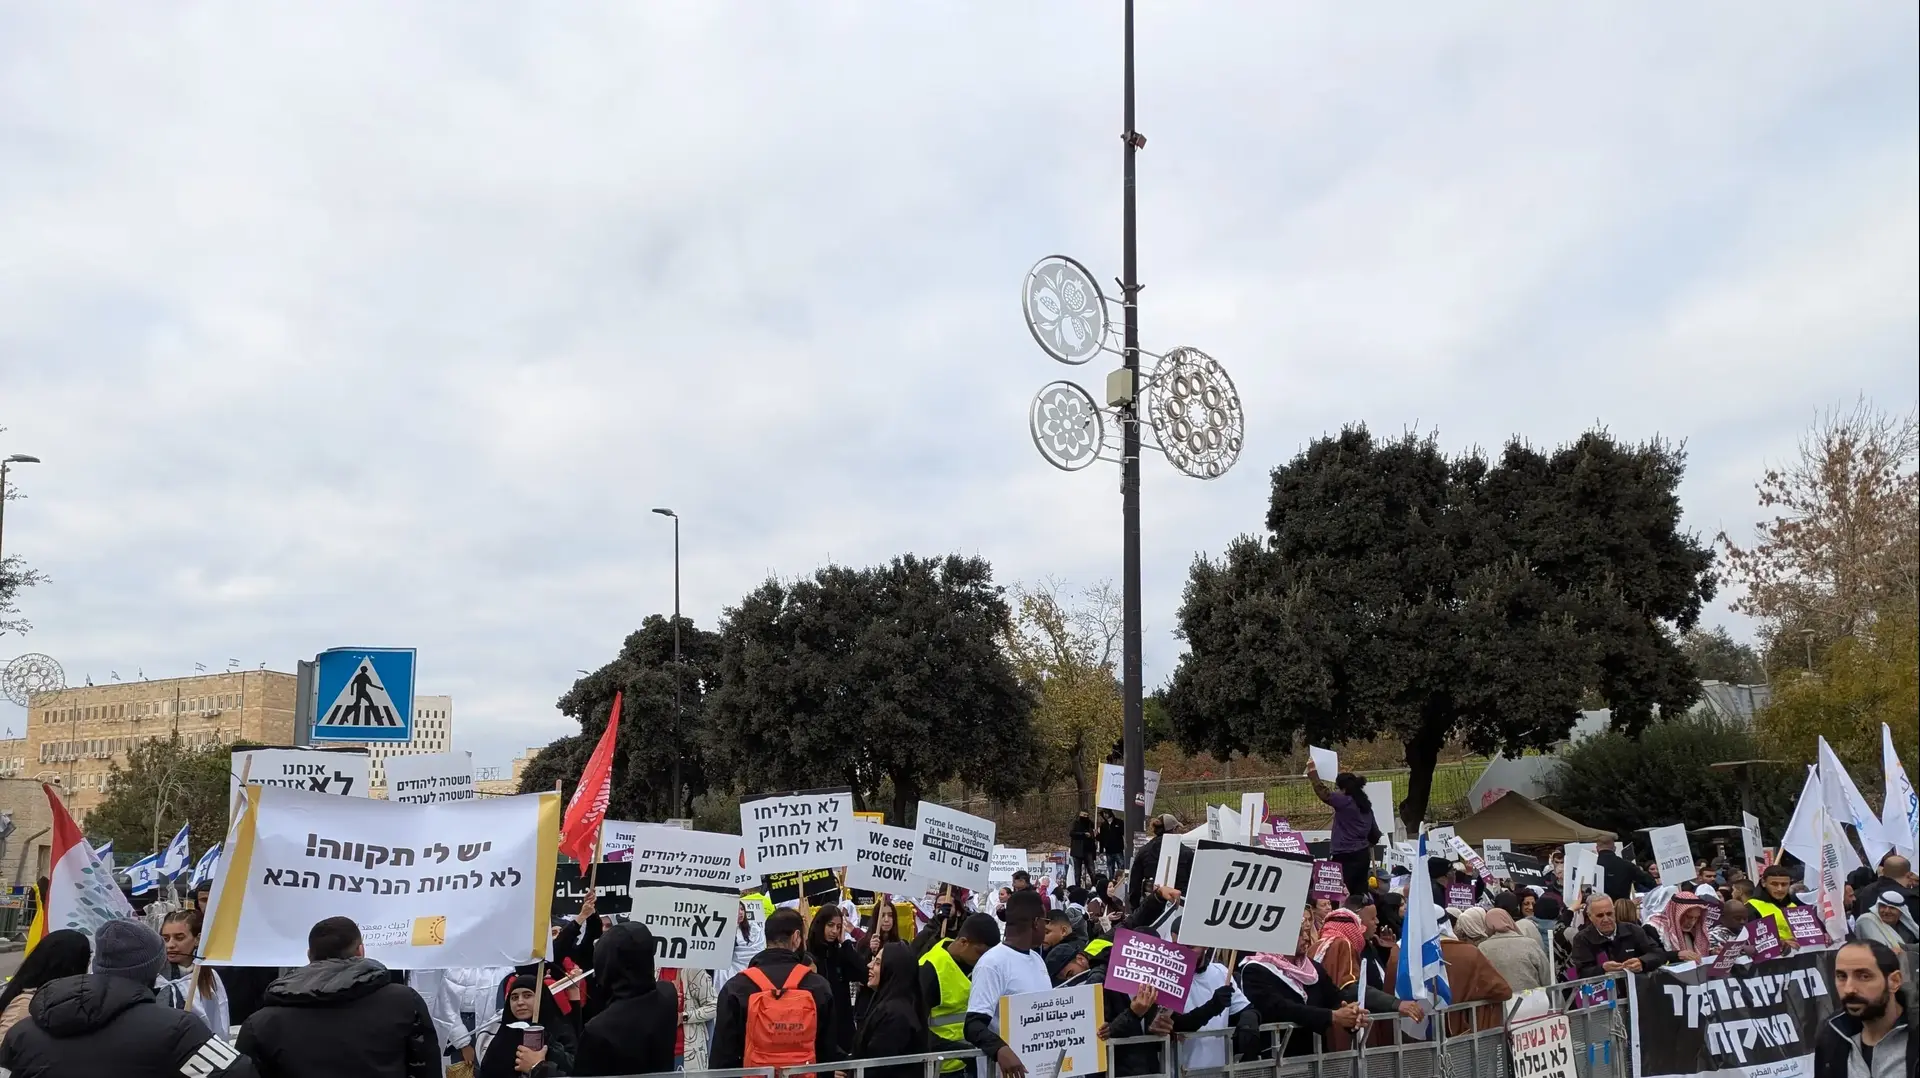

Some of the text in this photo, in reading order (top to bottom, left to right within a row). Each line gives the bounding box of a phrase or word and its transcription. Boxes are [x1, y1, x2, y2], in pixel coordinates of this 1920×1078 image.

[282, 764, 326, 775] אנחנו
[397, 775, 471, 791] משטרה ליהודים
[439, 789, 474, 802] ומשטרה
[754, 798, 839, 820] לא תצליחו
[759, 819, 811, 842] למחוק
[817, 817, 839, 833] לא
[924, 817, 991, 842] crime is contagious,
[869, 831, 890, 846] We
[929, 826, 986, 849] it has no borders
[305, 833, 492, 870] יש לי תקווה!
[641, 850, 687, 862] ליהודים
[757, 836, 844, 862] ולא לחמוק
[927, 836, 986, 860] and will destroy
[639, 863, 682, 876] לערבים
[689, 854, 732, 866] משטרה
[929, 849, 980, 873] all of us
[263, 866, 522, 895] לא להיות הנרצח הבא
[683, 867, 731, 880] ומשטרה
[871, 864, 907, 882] NOW.
[1219, 860, 1283, 896] חוק
[674, 901, 708, 914] אנחנו
[1203, 898, 1286, 932] פשע
[645, 914, 691, 928] אזרחים
[691, 910, 728, 938] לא
[689, 939, 716, 951] מסוג
[1128, 936, 1185, 960] حكومة دموية
[1124, 947, 1185, 973] ממשלת דמים
[1116, 968, 1182, 996] הורגת את כולנו
[1055, 996, 1074, 1008] الحياة
[1046, 1010, 1068, 1022] حياتنا
[1070, 1009, 1086, 1020] بس
[1030, 1027, 1076, 1041] החיים קצרים,
[1550, 1018, 1567, 1043] לא
[1021, 1036, 1086, 1054] אבל שלנו יותר!
[1550, 1042, 1568, 1068] לא
[180, 1034, 241, 1078] PU
